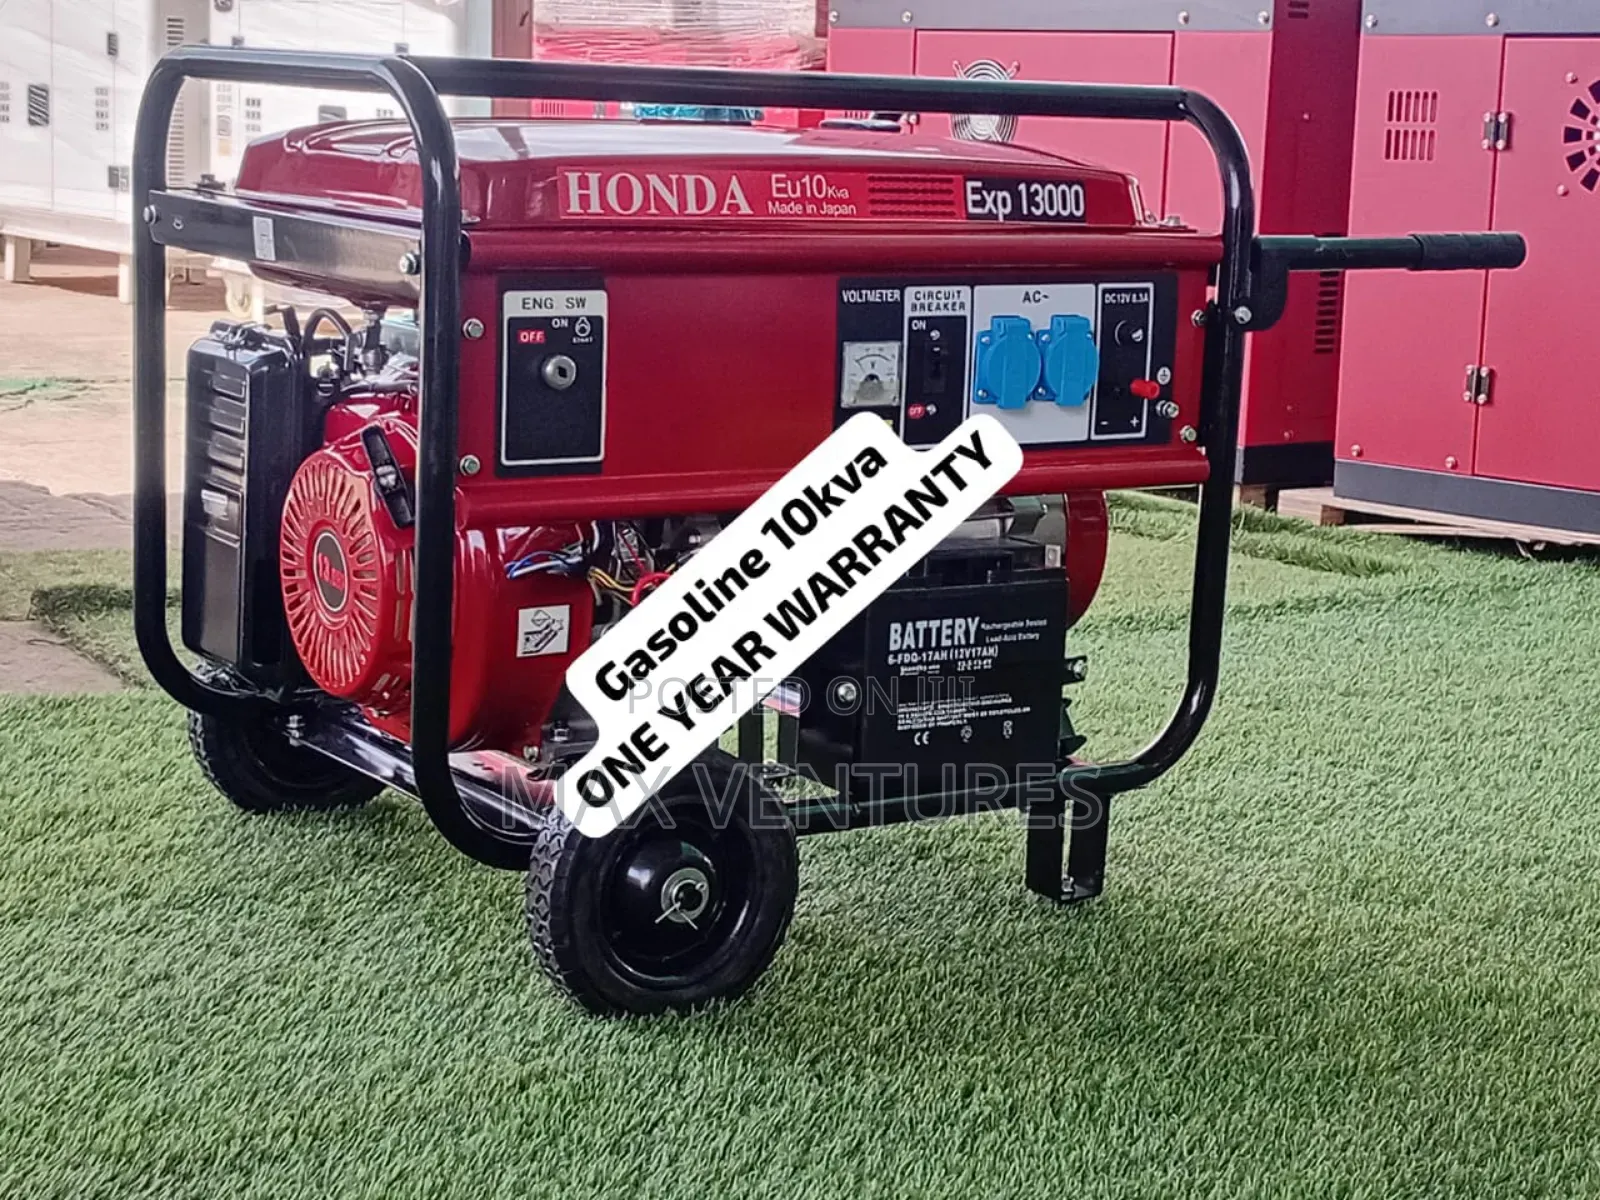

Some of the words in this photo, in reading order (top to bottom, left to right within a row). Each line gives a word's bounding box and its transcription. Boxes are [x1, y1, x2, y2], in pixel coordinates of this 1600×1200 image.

[564, 172, 754, 215] HONDA
[966, 181, 1011, 221] Exp
[1017, 183, 1084, 217] 13000
[768, 201, 803, 214] Made
[806, 201, 817, 214] in
[819, 201, 857, 216] Japan
[842, 289, 900, 302] VOLTMETER
[914, 290, 962, 301] CIRCUIT
[521, 297, 554, 310] ENG
[565, 297, 587, 309] SW
[910, 301, 966, 312] BREAKER
[551, 318, 569, 329] ON
[911, 319, 927, 331] ON
[519, 331, 545, 343] OFF
[889, 616, 980, 651] BATTERY
